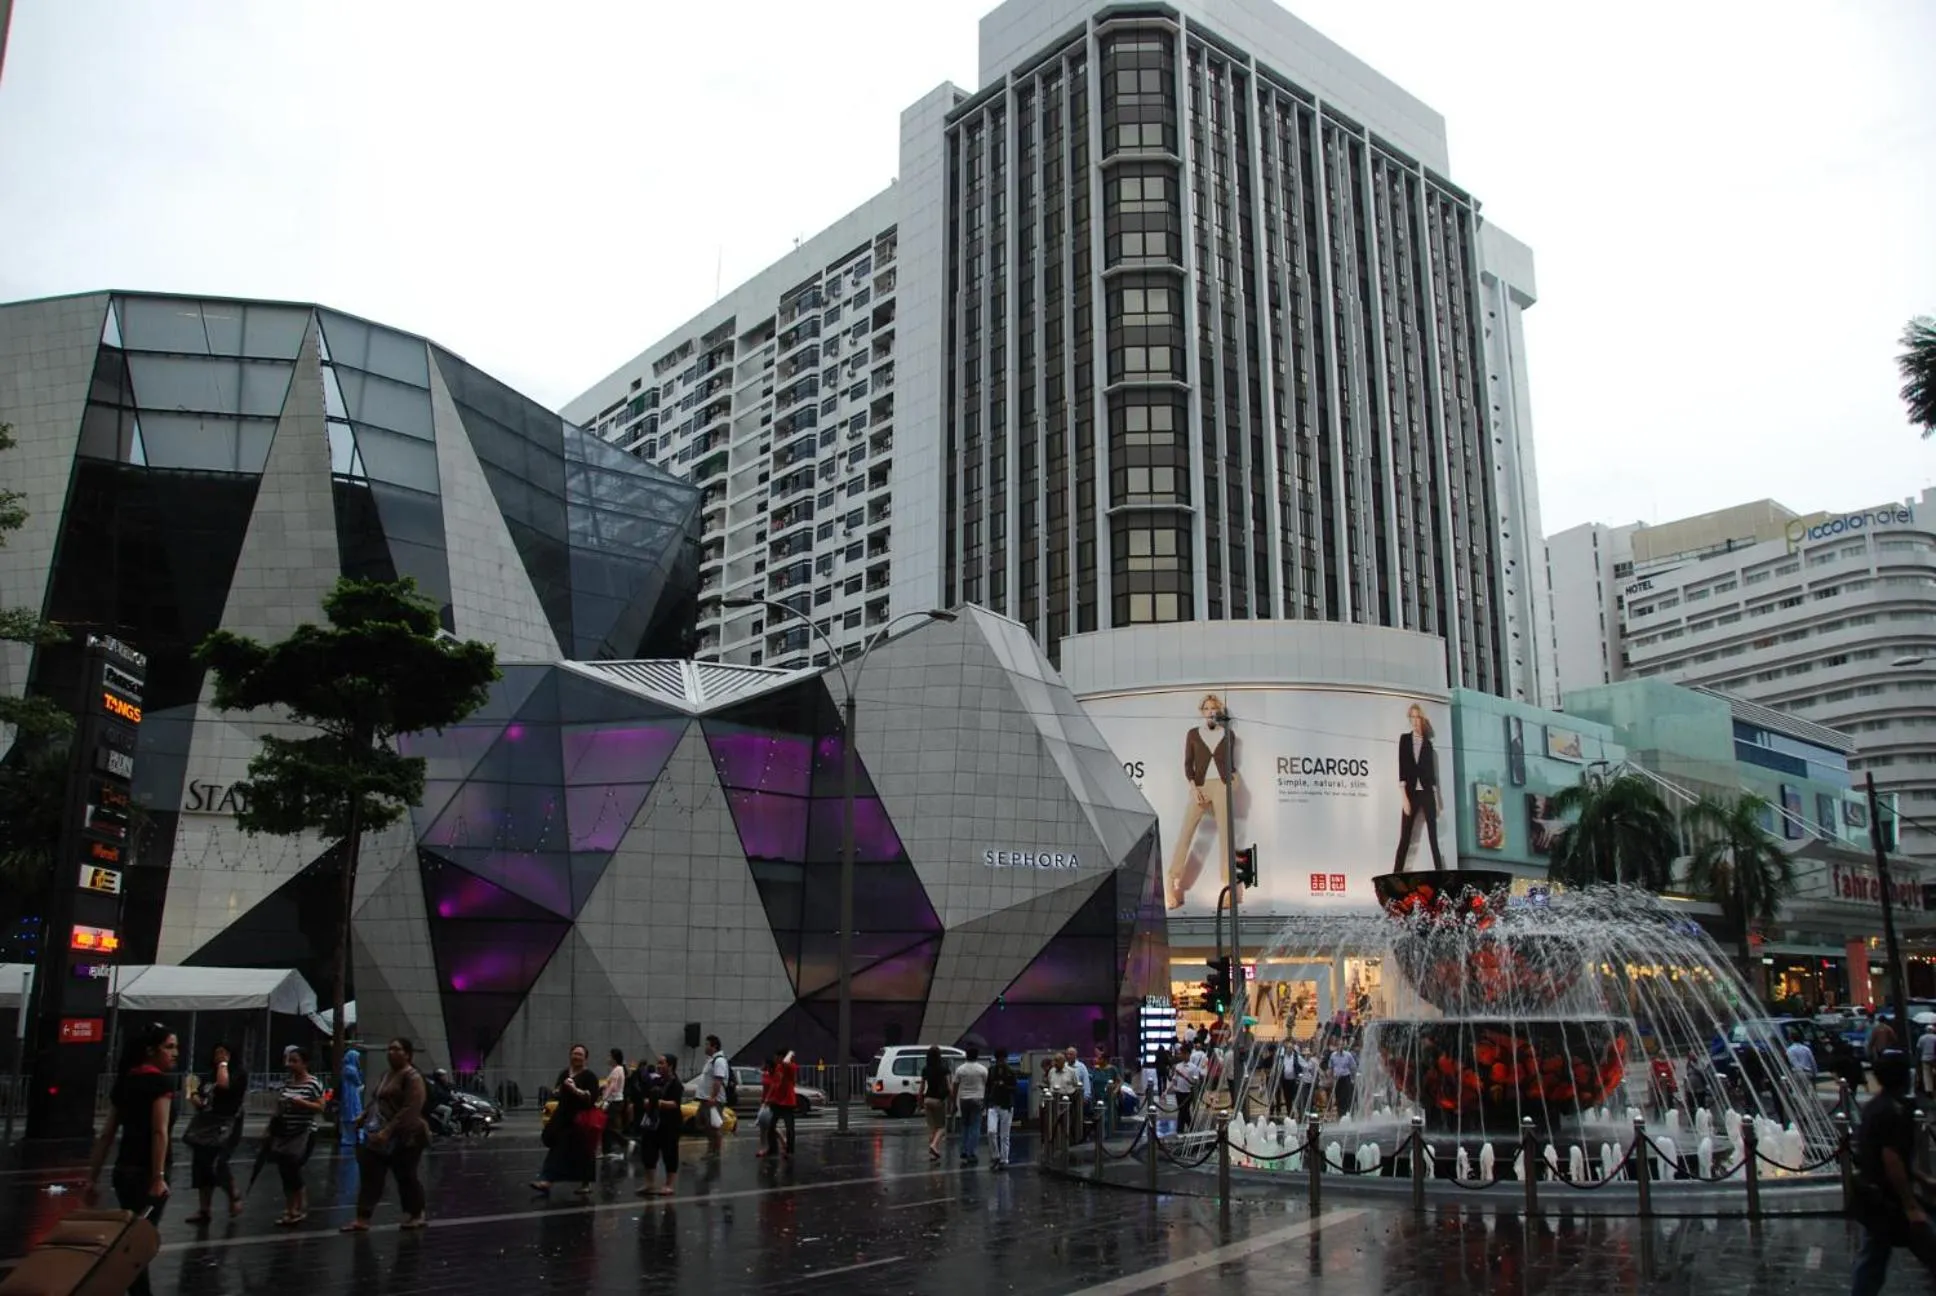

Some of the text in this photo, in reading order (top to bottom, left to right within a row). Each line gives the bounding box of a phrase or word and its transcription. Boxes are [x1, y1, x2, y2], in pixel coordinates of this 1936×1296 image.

[1625, 580, 1654, 596] HOTEL
[104, 693, 141, 723] TANGS
[1277, 757, 1369, 776] RECARGOS
[1278, 778, 1309, 788] Simple,
[1313, 779, 1347, 788] natural,
[986, 850, 1079, 868] SEPHORA
